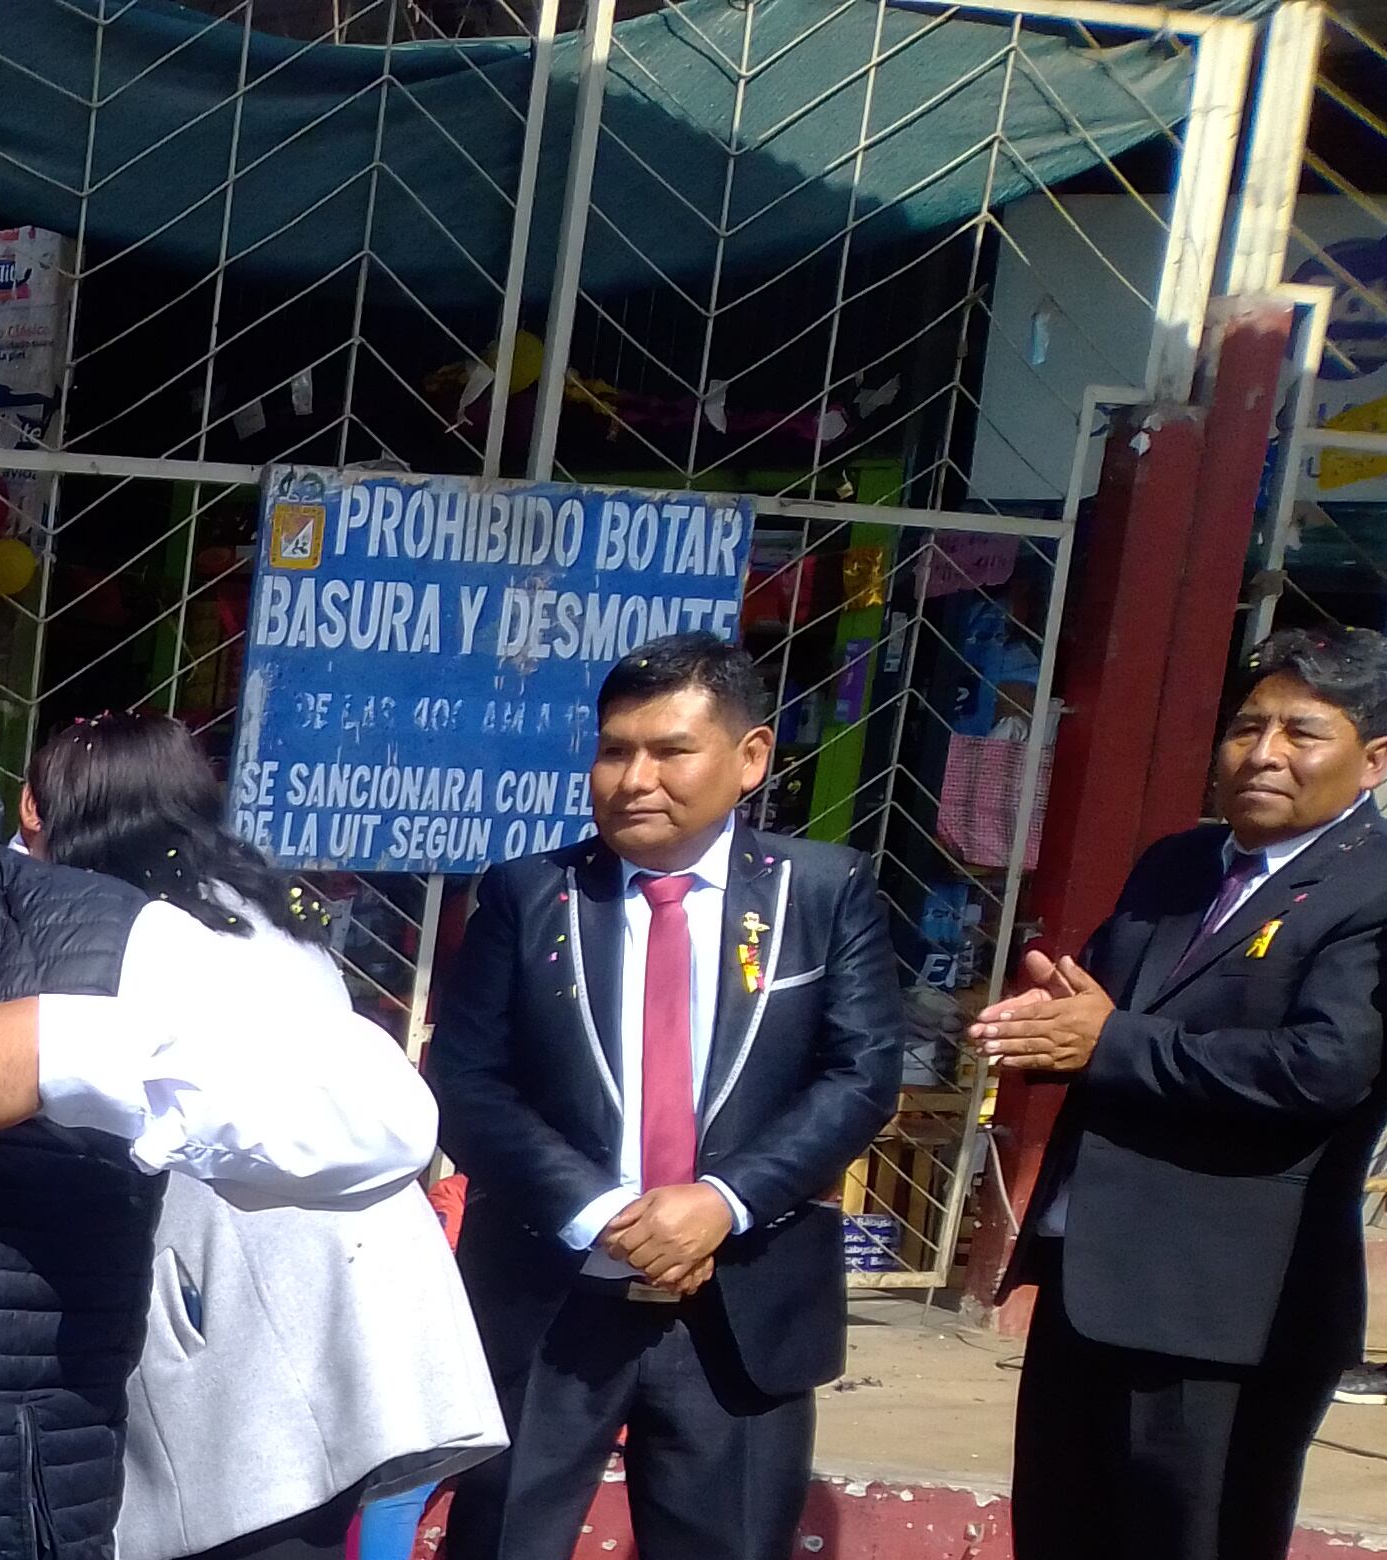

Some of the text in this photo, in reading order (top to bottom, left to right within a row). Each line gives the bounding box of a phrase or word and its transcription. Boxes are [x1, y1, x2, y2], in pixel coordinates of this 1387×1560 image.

[334, 484, 743, 576] PROHIBIDO BOTAR
[256, 574, 442, 653] BASURA
[458, 586, 488, 654] Y
[240, 761, 279, 805] SE
[286, 762, 484, 812] SANCIONARA
[495, 770, 560, 815] CON
[236, 809, 274, 851] DE
[279, 811, 319, 857] LA
[329, 812, 382, 858] UIT
[390, 815, 493, 862] SEGUN
